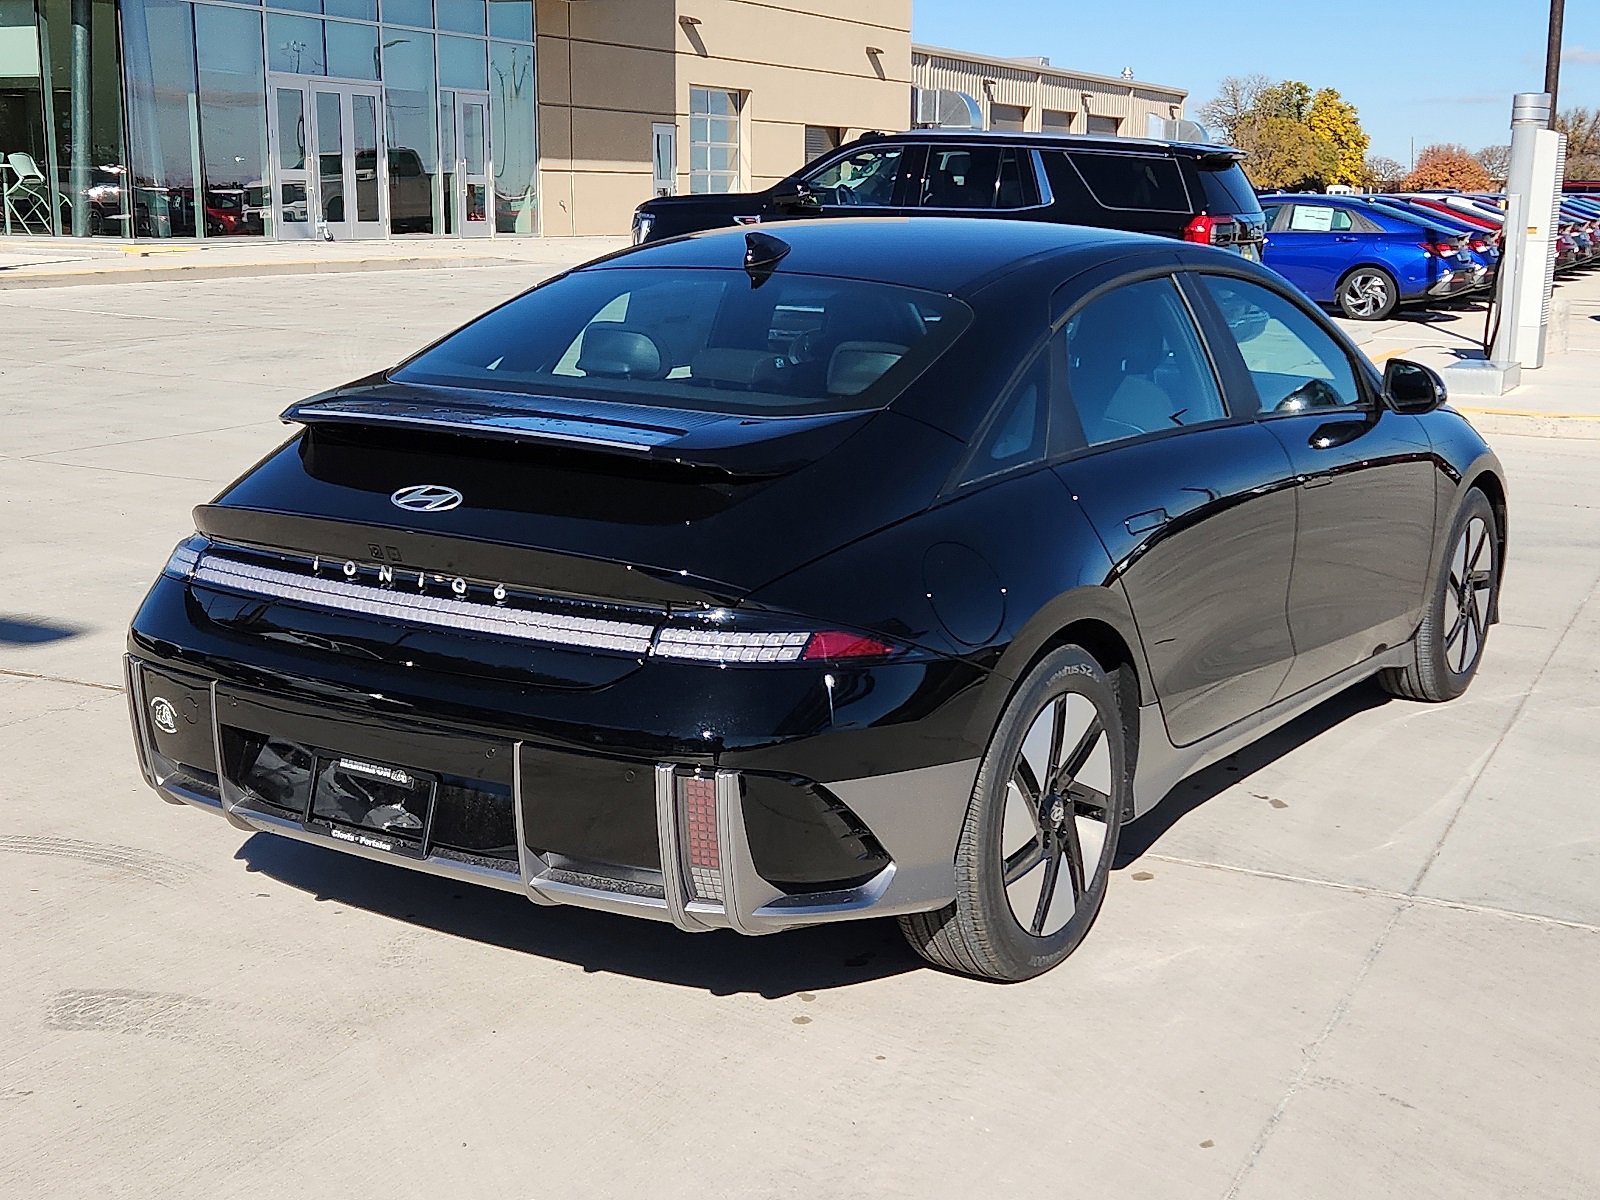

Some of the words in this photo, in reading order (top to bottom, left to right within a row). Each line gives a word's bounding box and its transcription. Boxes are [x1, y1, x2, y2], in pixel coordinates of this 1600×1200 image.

[313, 555, 467, 594] IONIQ
[331, 829, 355, 843] Clovis
[359, 836, 391, 851] Portales
